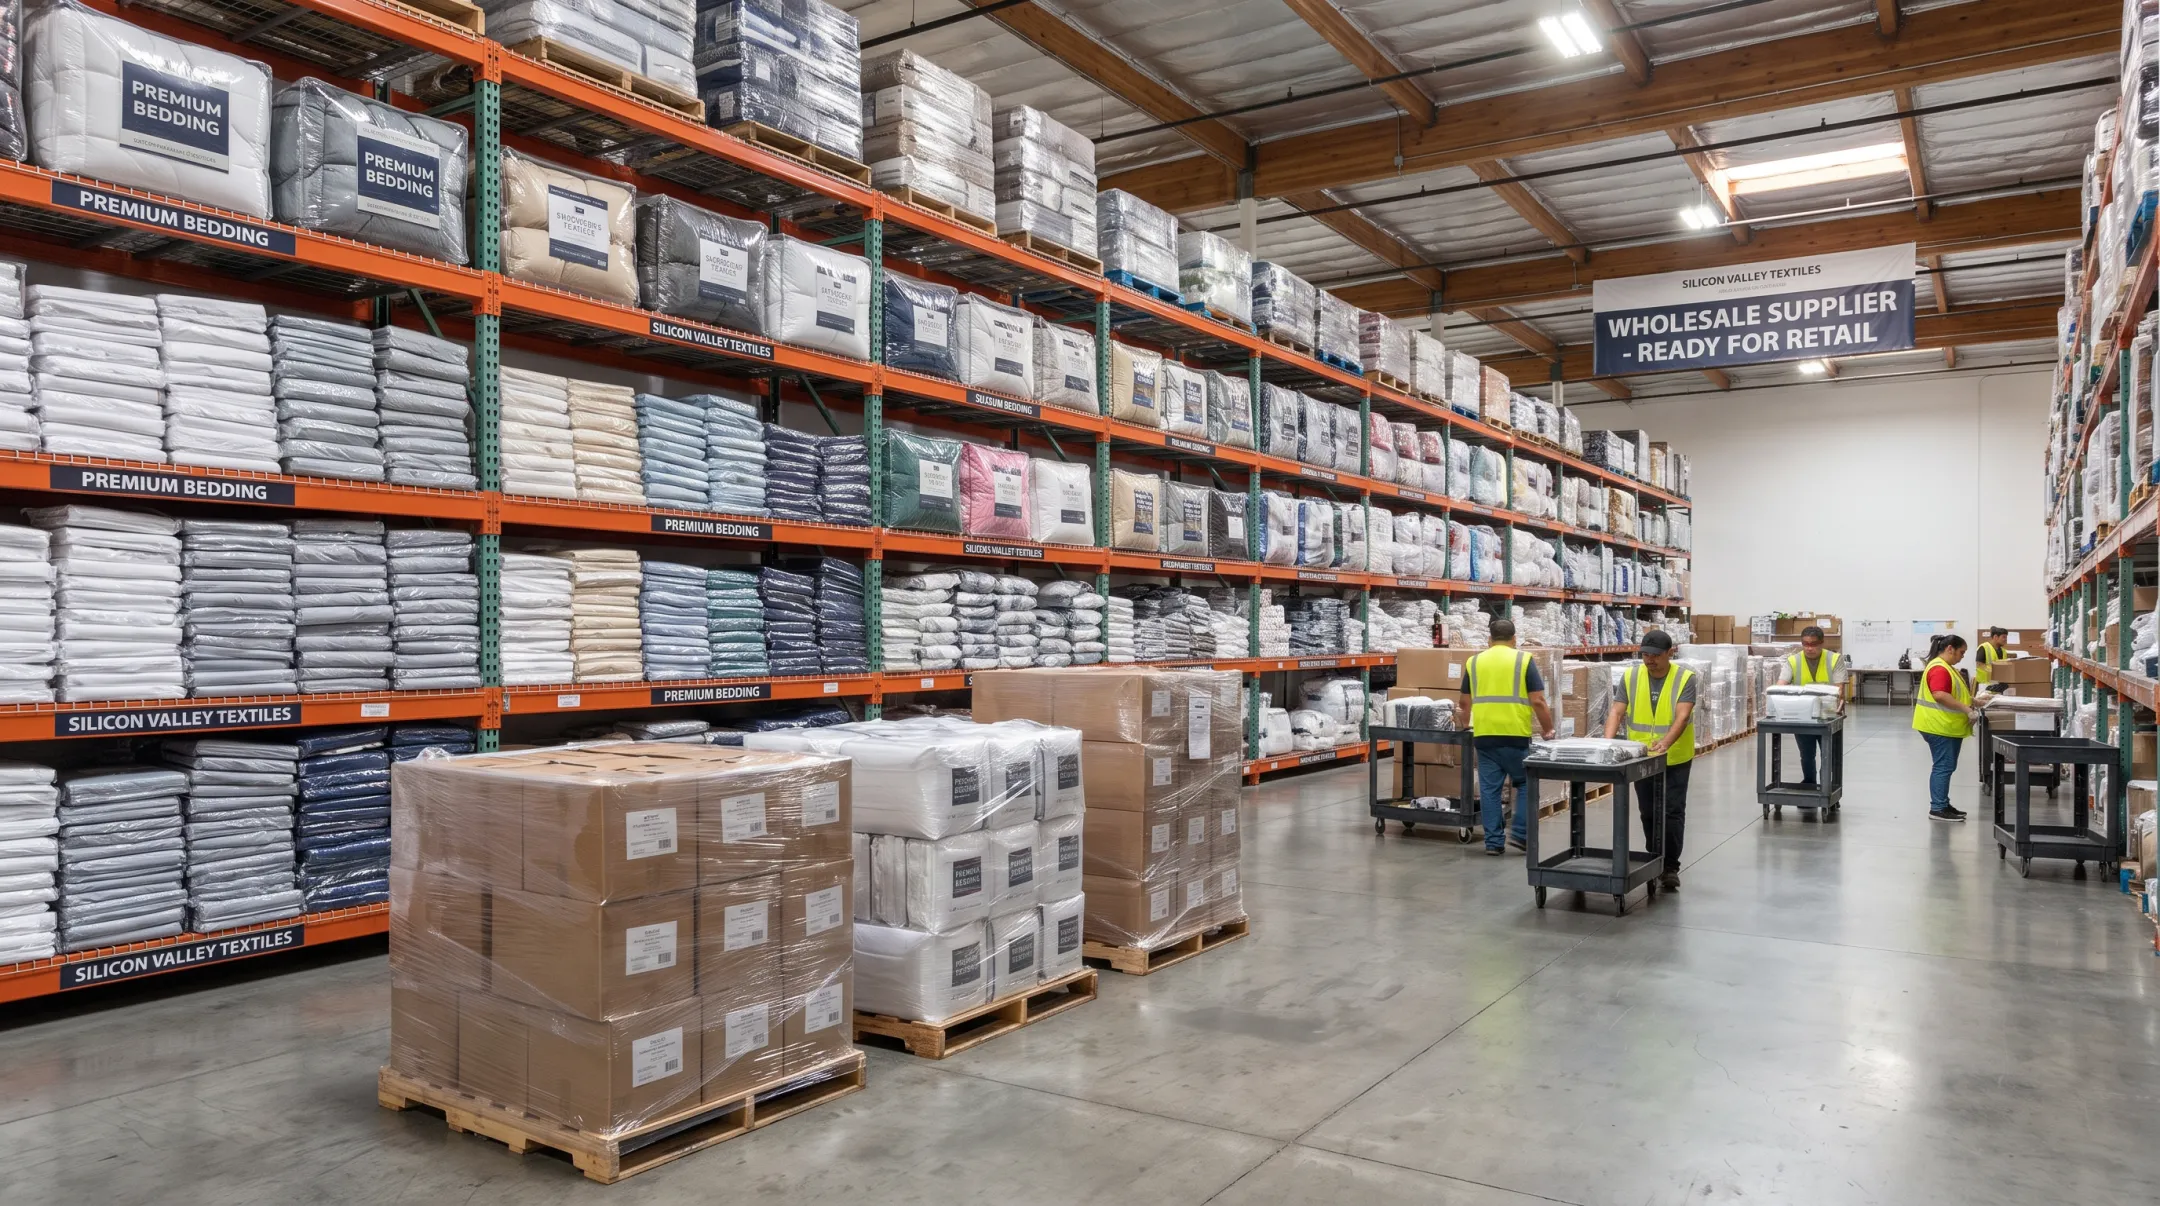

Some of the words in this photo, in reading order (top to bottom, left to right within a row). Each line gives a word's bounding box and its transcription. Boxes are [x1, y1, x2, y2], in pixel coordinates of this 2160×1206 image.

[132, 80, 222, 118] PREMIUM
[133, 100, 220, 136] BEDDING
[364, 151, 434, 182] PREMIUM
[366, 169, 433, 198] BEDDING
[79, 190, 178, 227] PREMIUM
[183, 214, 269, 247] BEDDING
[1682, 275, 1725, 289] SILICON
[1727, 271, 1768, 283] VALLEY
[1769, 265, 1822, 279] TEXTILES
[1608, 304, 1761, 338] WHOLESALE
[1767, 290, 1898, 324] SUPPLIER
[652, 322, 692, 340] SILICON
[693, 331, 729, 348] VALLEY
[730, 339, 771, 357] TEXTILES
[1638, 336, 1721, 363] READY
[1727, 330, 1779, 355] FOR
[1786, 321, 1878, 350] RETAIL
[82, 471, 179, 494] PREMIUM
[184, 479, 267, 500] BEDDING
[665, 518, 714, 534] PREMIUM
[716, 523, 759, 537] BEDDING
[664, 688, 714, 702] PREMIUM
[716, 686, 760, 699] BEDDING
[68, 714, 144, 732] SILICON
[147, 710, 212, 727] VALLEY
[216, 707, 291, 723] TEXTILES
[75, 956, 148, 982] SILICON
[152, 944, 217, 968] VALLEY
[219, 931, 293, 956] TEXTILES
